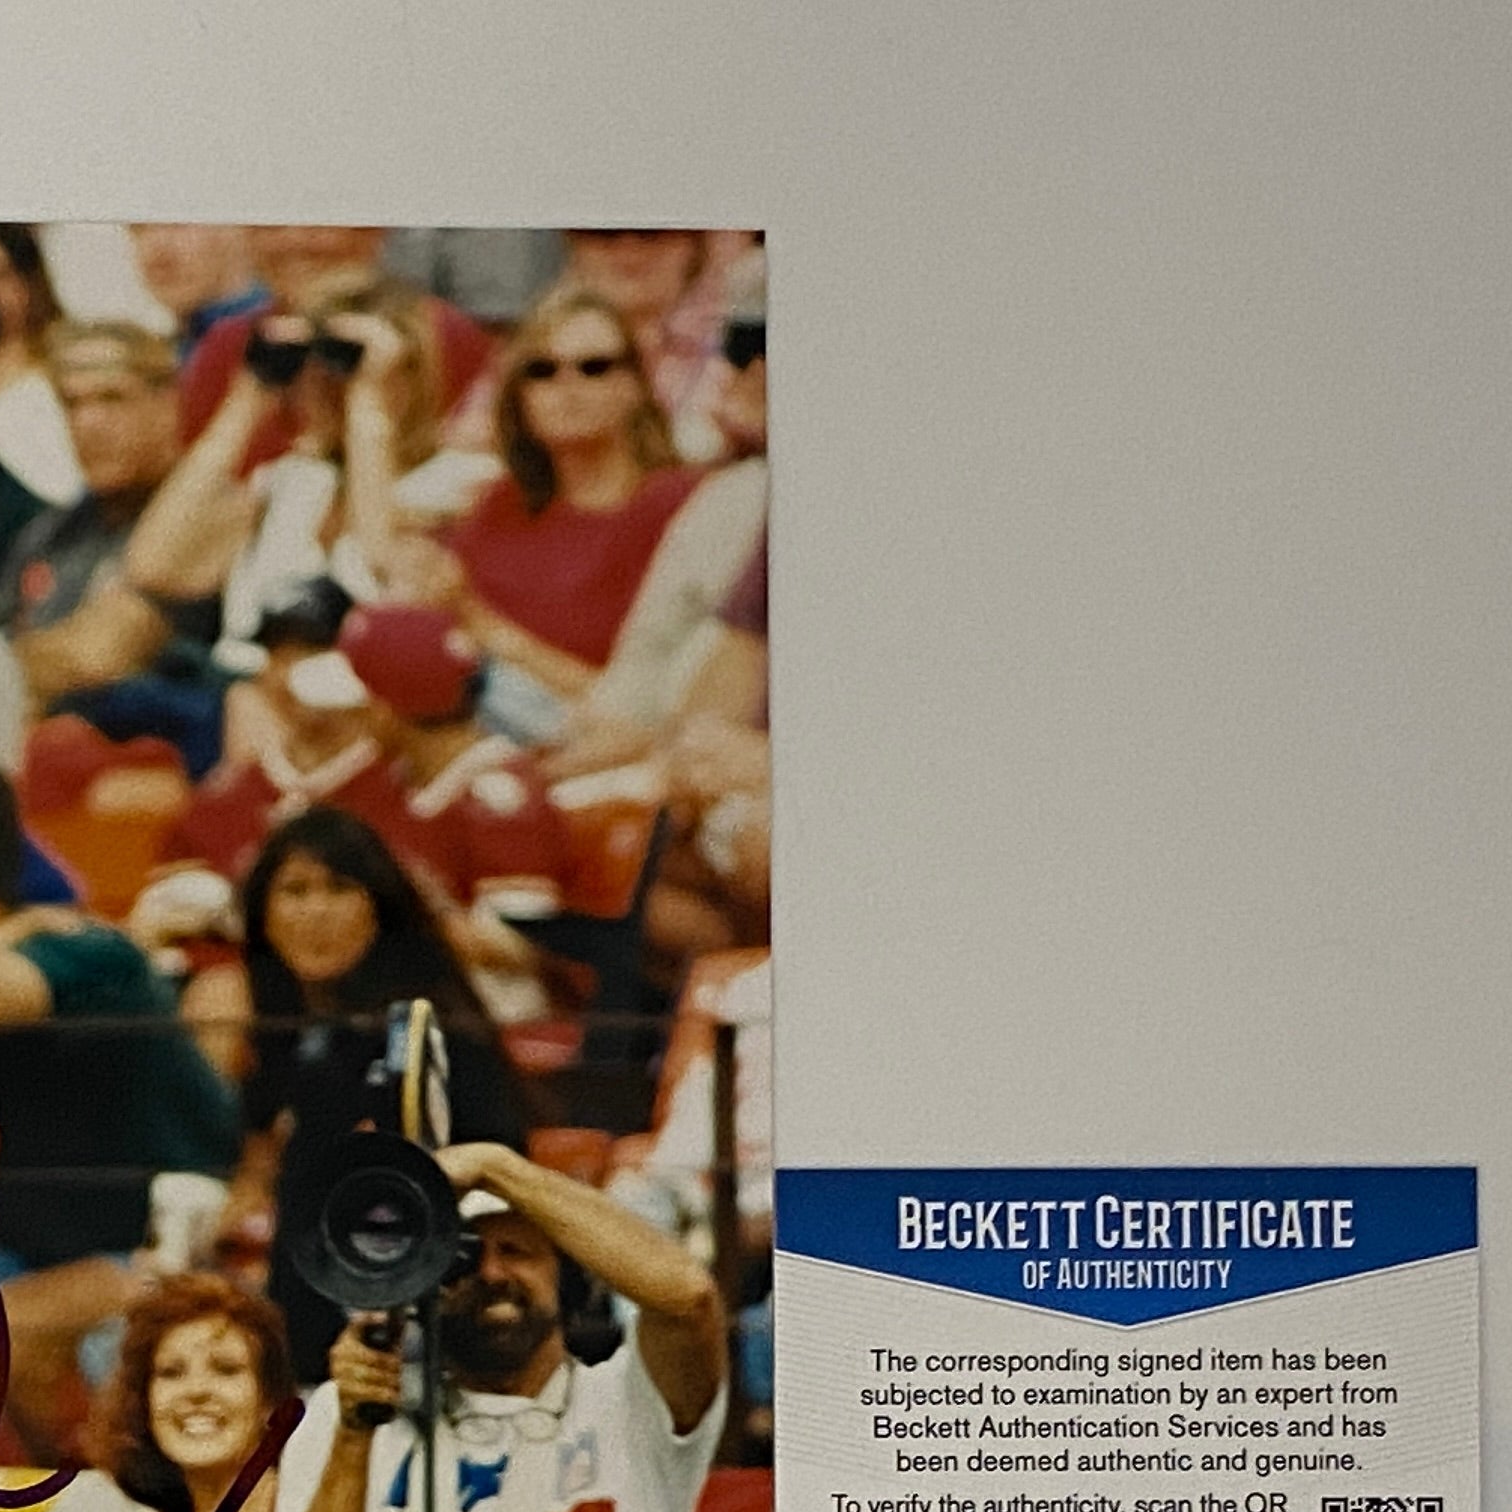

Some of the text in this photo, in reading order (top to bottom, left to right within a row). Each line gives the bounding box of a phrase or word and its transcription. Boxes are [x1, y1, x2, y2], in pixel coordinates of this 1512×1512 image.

[897, 1192, 1357, 1251] BECKETT CERTIFICATE
[1022, 1257, 1233, 1291] OF AUTHENTICITY
[869, 1346, 1387, 1377] The corresponding signed item has been
[860, 1380, 1398, 1410] subjected to examination by an expert from
[873, 1413, 1387, 1439] Beckett Authentication Services and has
[896, 1447, 1363, 1476] been deemed authentic and genuine.
